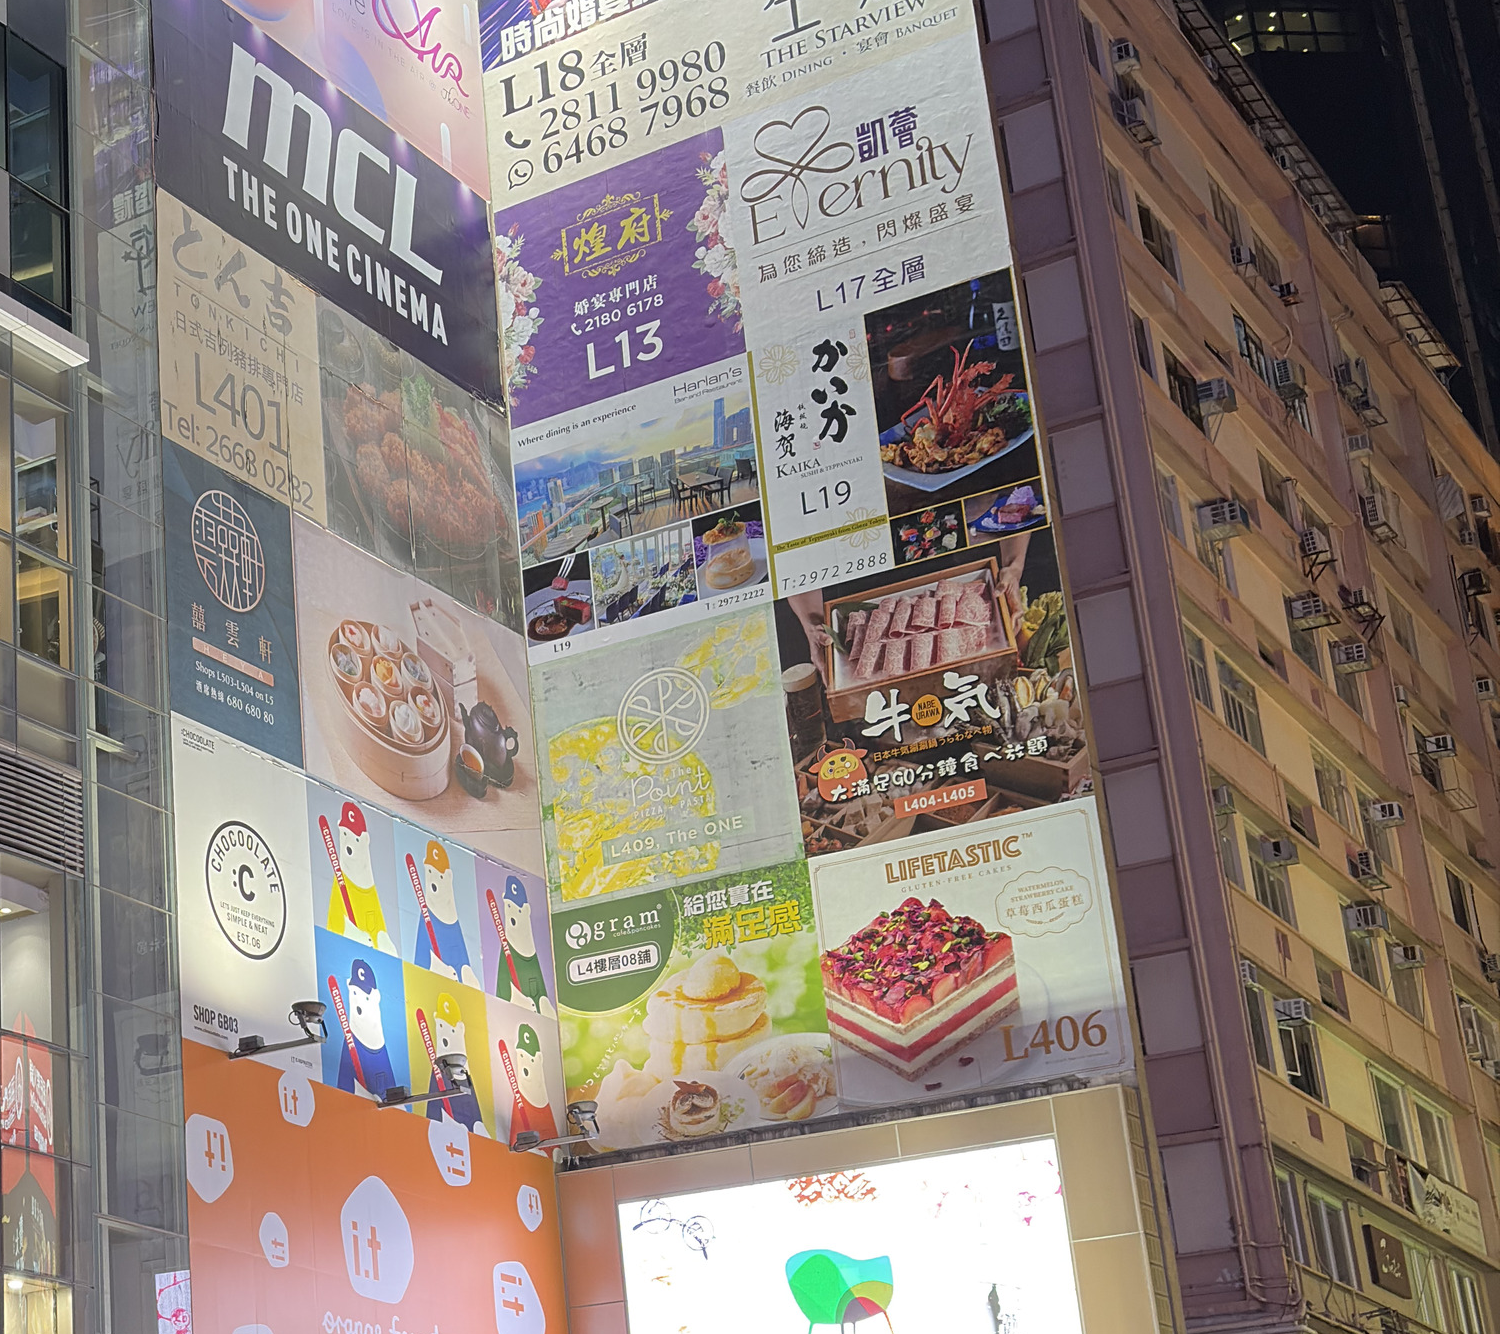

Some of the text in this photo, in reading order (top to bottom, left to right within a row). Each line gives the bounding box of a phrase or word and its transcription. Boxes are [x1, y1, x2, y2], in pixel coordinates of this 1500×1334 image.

[760, 38, 808, 69] THE
[782, 56, 833, 83] DINING
[895, 7, 959, 38] BANQUET
[539, 40, 726, 141] 2811 9980
[543, 76, 730, 174] 6468 7968
[855, 105, 919, 163] 凱薈
[223, 156, 278, 230] THE
[286, 202, 340, 273] ONE
[346, 243, 448, 346] CINEMA
[573, 207, 652, 264] 煌府
[172, 206, 296, 338] とん吉
[816, 255, 926, 312] L17全層
[573, 274, 659, 317] 婚宴專門店
[584, 294, 664, 333] 2180 6178
[586, 319, 664, 380] L13
[673, 367, 743, 397] Harlan's
[702, 378, 744, 397] Restaurant
[811, 338, 857, 444] かいか
[194, 351, 289, 458] L401
[517, 403, 637, 448] Where dining is an experience
[163, 399, 315, 512] Tel: 2668 0282
[776, 457, 821, 479] KAIKA
[800, 456, 863, 480] SUSHI TEPPANYAKI
[801, 480, 851, 515] L19
[845, 553, 887, 574] 2888
[718, 588, 765, 608] 2972 2222
[553, 639, 572, 654] L19
[195, 660, 274, 706] Shops L503-L504 on L5
[226, 693, 274, 726] 680 680 80
[915, 708, 940, 721] URAWA
[917, 699, 936, 711] NABE
[631, 765, 711, 807] Point
[671, 766, 692, 779] The
[634, 794, 712, 819] PIZZA PASTA
[904, 787, 975, 813] L404-L405
[611, 815, 743, 858] L409, The ONE
[211, 829, 281, 894] CHOCOOLATE
[885, 835, 1022, 884] LIFETASTIC
[683, 879, 775, 917] 給您實在
[901, 865, 1013, 893] GLUTEN-FREE CAKES
[1010, 884, 1075, 903] STRAWBERRY CAKE
[1017, 878, 1065, 893] WATERMELON
[226, 912, 268, 936] SIMPLE NEAT
[593, 908, 660, 941] gram
[702, 899, 802, 950] 滿足感
[1005, 893, 1085, 919] 草莓西瓜蛋糕
[193, 1004, 216, 1026] SHOP
[218, 1012, 239, 1034] GB03
[1001, 1009, 1108, 1063] L406
[351, 1220, 382, 1281] i.t
